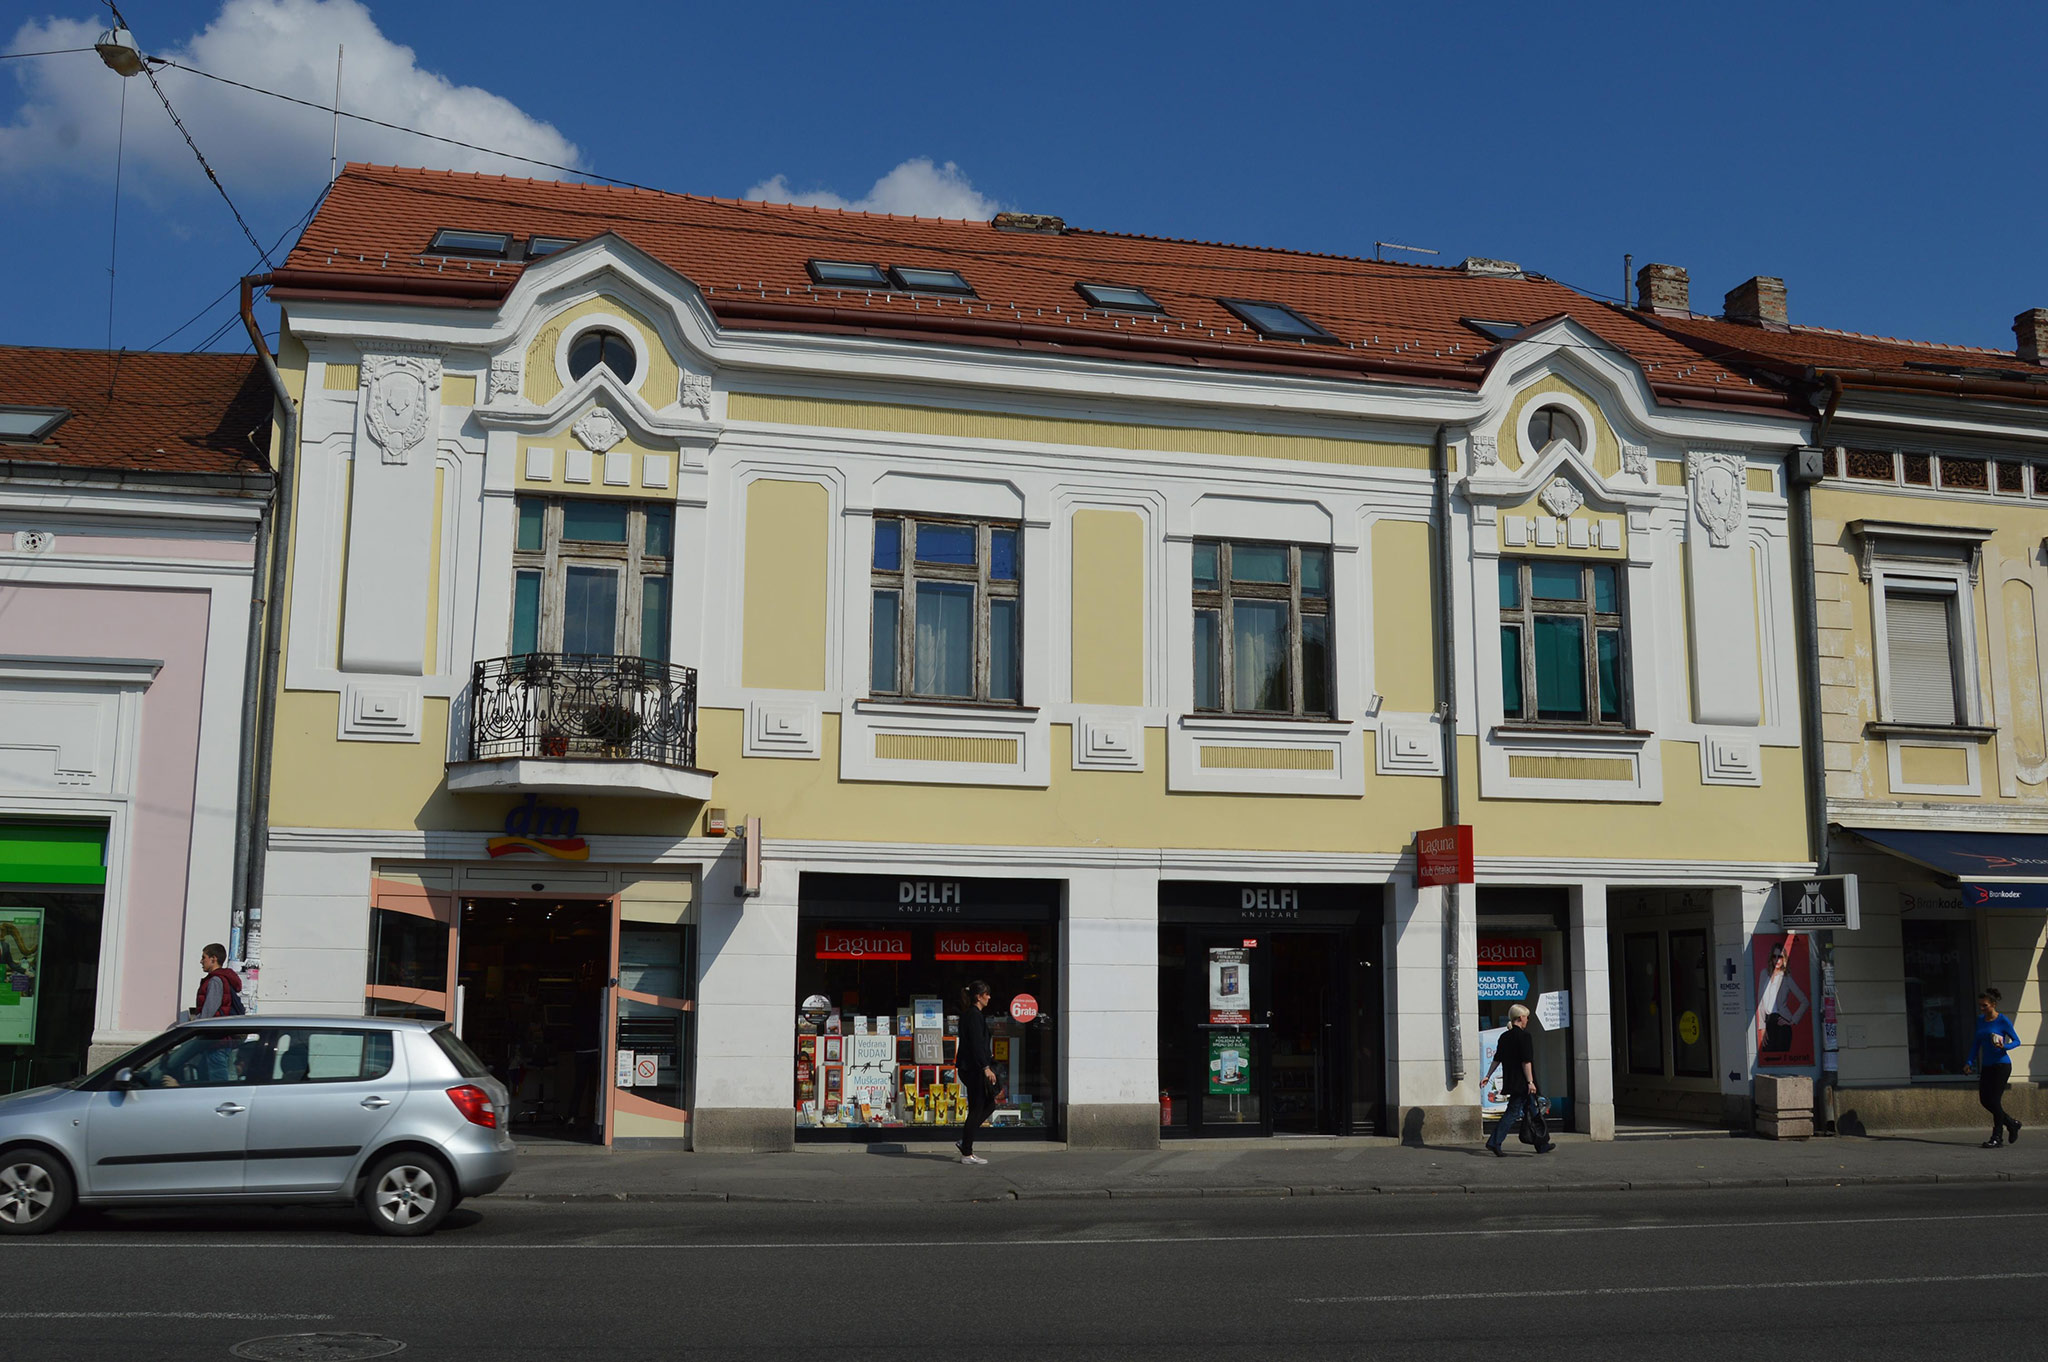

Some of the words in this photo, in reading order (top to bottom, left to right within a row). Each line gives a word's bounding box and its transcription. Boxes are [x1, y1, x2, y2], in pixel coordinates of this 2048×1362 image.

[504, 793, 579, 838] dm
[1421, 838, 1455, 856] Laguna
[899, 881, 961, 904] DELFI
[1241, 888, 1299, 910] DELFI
[1989, 890, 2021, 898] Brankodex
[898, 904, 961, 913] KNJIŽARE
[1917, 897, 1964, 909] Brankode
[1241, 911, 1299, 919] KNJIŽARE
[824, 935, 904, 956] Laguna
[941, 939, 970, 953] Klub
[975, 940, 1023, 953] čitalaca
[1477, 944, 1536, 962] aguna
[857, 1039, 887, 1048] Vedrana
[917, 1033, 939, 1044] DARK
[857, 1049, 887, 1058] RUDAN
[918, 1044, 940, 1059] NET
[853, 1075, 889, 1085] Muškarac
